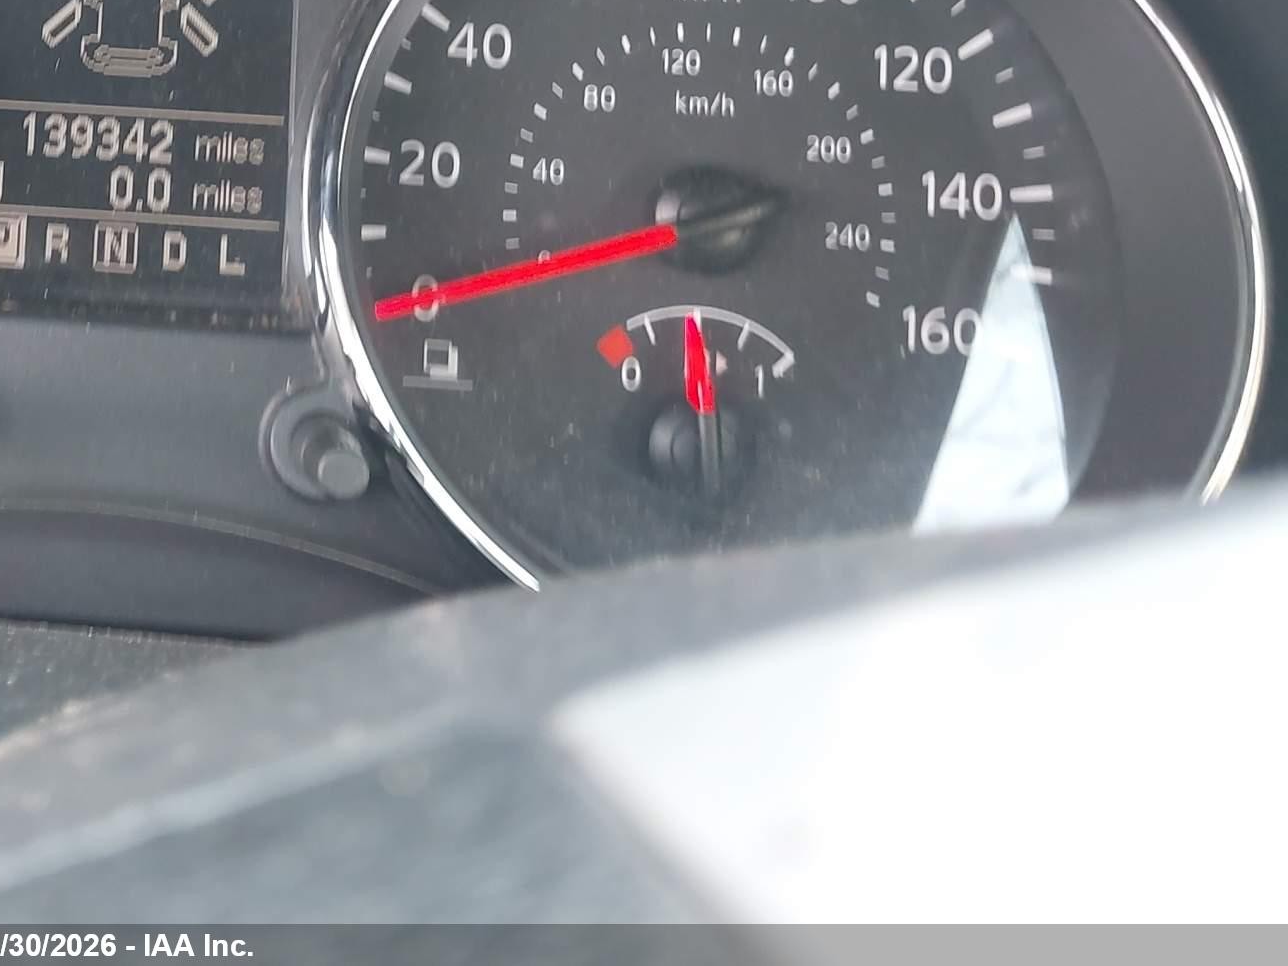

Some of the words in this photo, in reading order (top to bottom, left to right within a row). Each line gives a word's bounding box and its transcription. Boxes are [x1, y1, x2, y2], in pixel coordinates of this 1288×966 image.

[446, 21, 513, 70] 40
[662, 47, 702, 76] 120
[753, 68, 795, 97] 160
[873, 43, 954, 94] 120
[582, 83, 617, 112] 80
[675, 89, 736, 119] km/h
[23, 111, 175, 165] 139342
[194, 131, 264, 165] miles
[806, 133, 852, 164] 200
[398, 138, 462, 189] 20
[532, 157, 566, 186] 40
[109, 165, 172, 213] 0.0
[192, 179, 263, 214] miles
[921, 169, 1003, 222] 140
[45, 222, 70, 264] R
[162, 230, 187, 272] D
[219, 233, 246, 276] L
[824, 221, 871, 252] 240
[902, 305, 984, 356] 160
[621, 356, 642, 392] 0
[754, 363, 765, 399] 1
